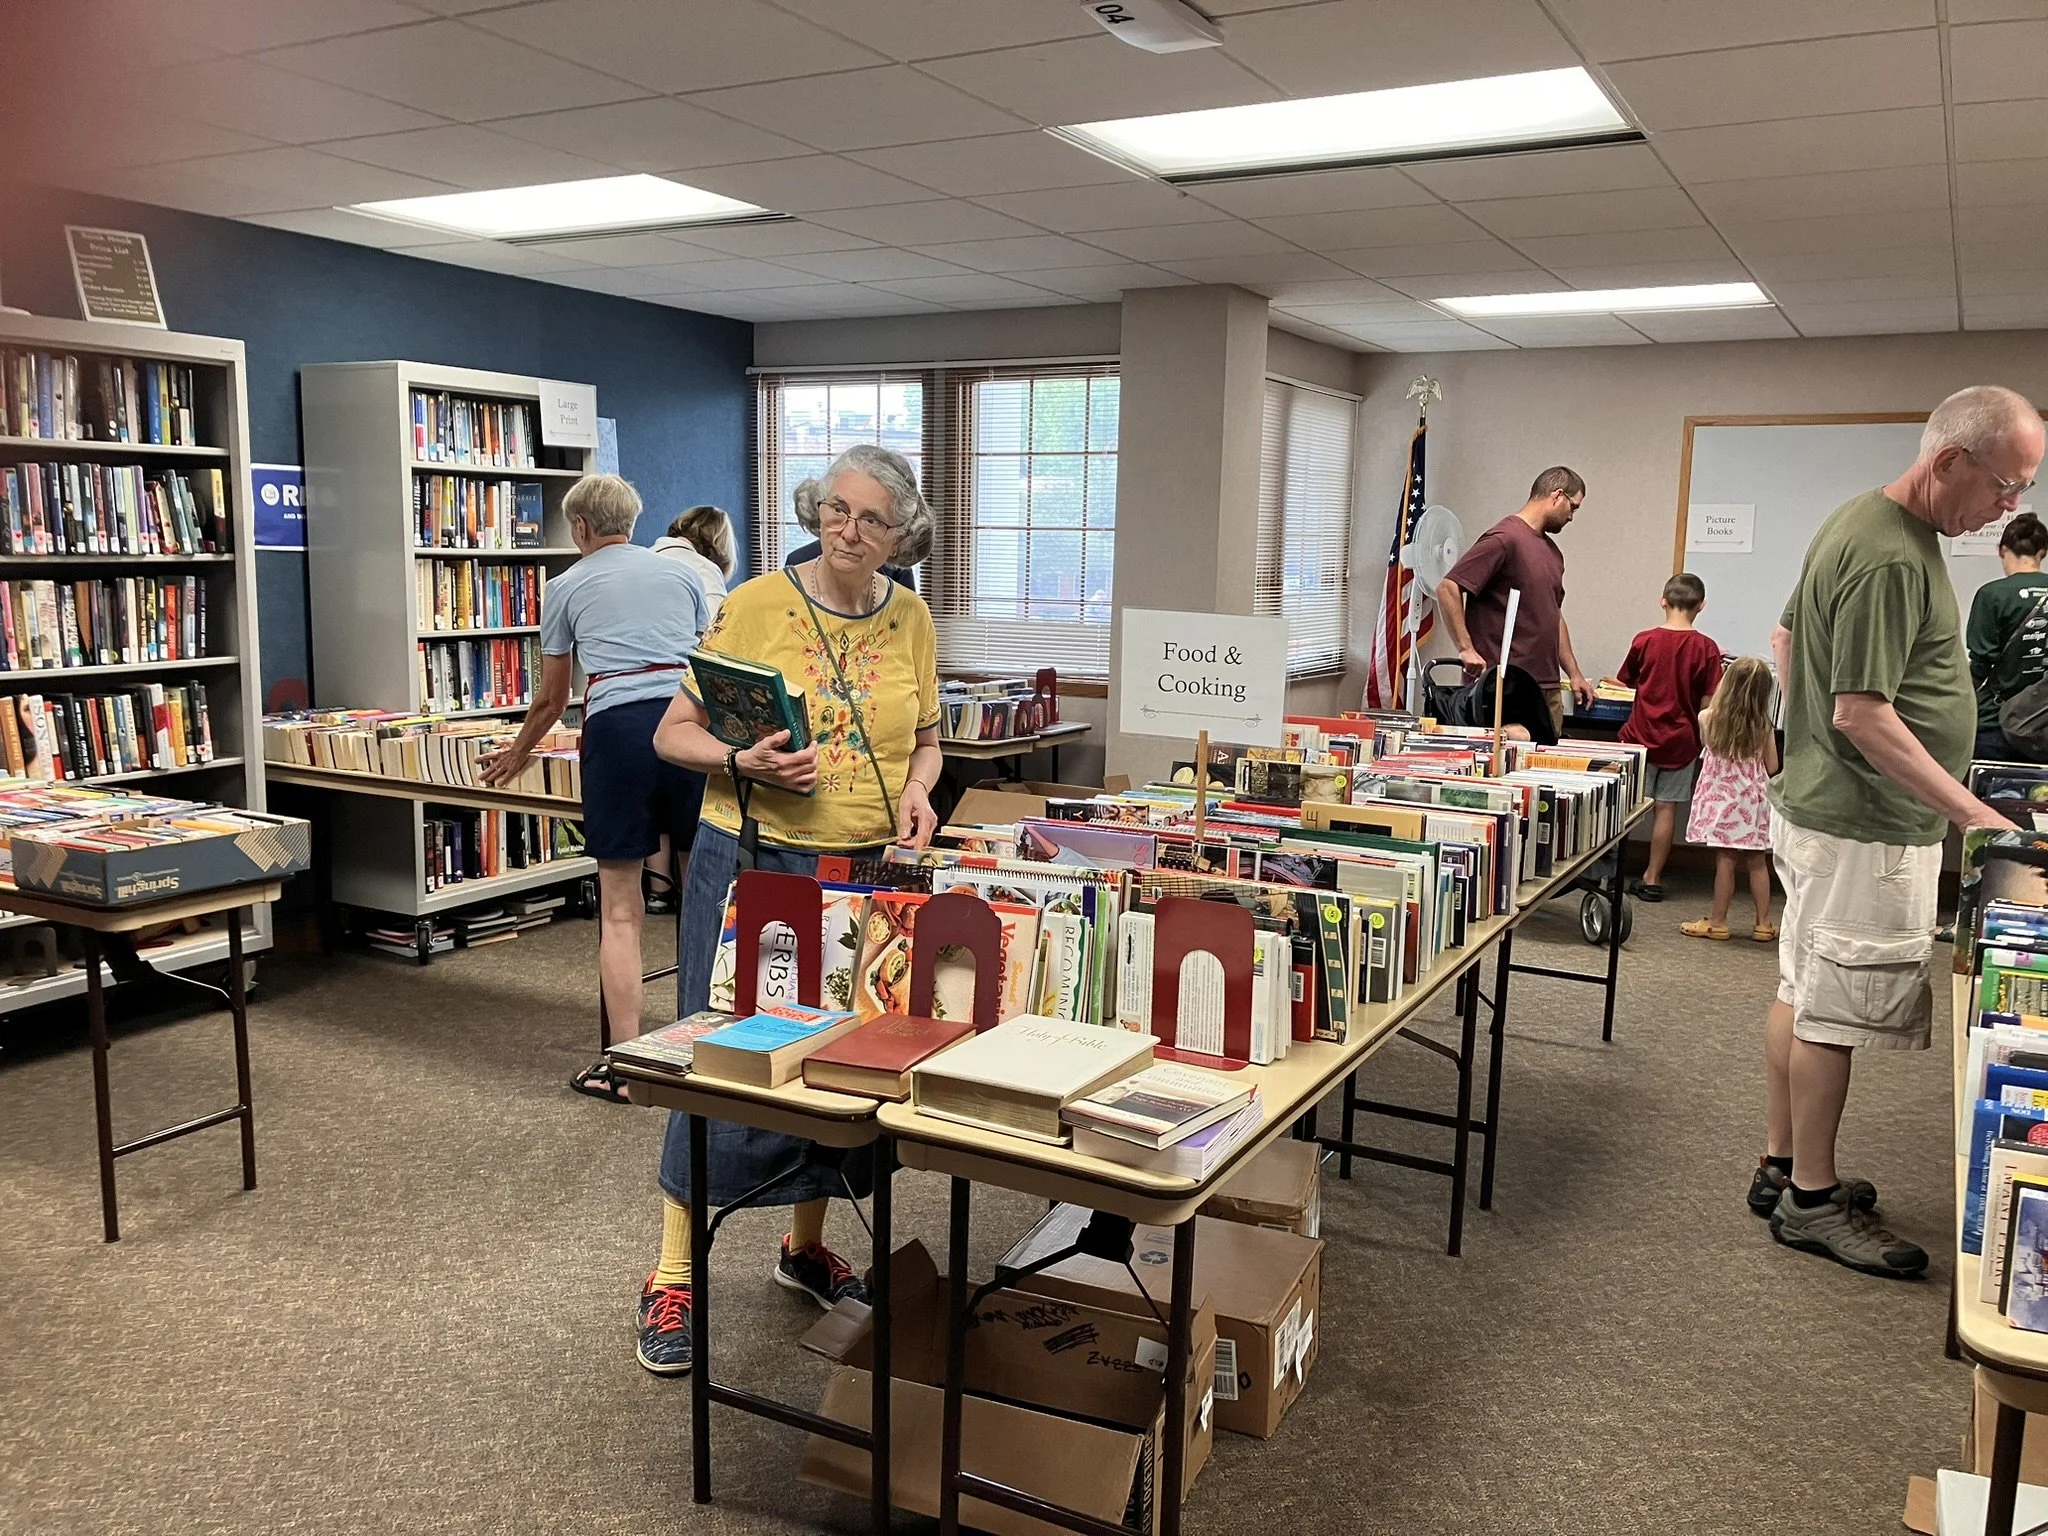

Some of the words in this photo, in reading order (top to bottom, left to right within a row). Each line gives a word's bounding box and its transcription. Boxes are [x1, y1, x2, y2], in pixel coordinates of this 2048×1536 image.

[1095, 4, 1135, 24] 04
[557, 398, 579, 411] Large
[560, 414, 578, 425] Print
[1705, 515, 1736, 524] Picture
[1707, 527, 1733, 535] Books
[1163, 642, 1217, 663] Food
[1224, 646, 1243, 665] &
[1157, 673, 1247, 703] Cooking
[117, 876, 180, 899] Springhill
[1017, 1024, 1055, 1047] Holy
[1060, 1031, 1107, 1050] Bible
[1163, 1067, 1229, 1088] Covenant
[1143, 1432, 1154, 1511] TOGETHER
